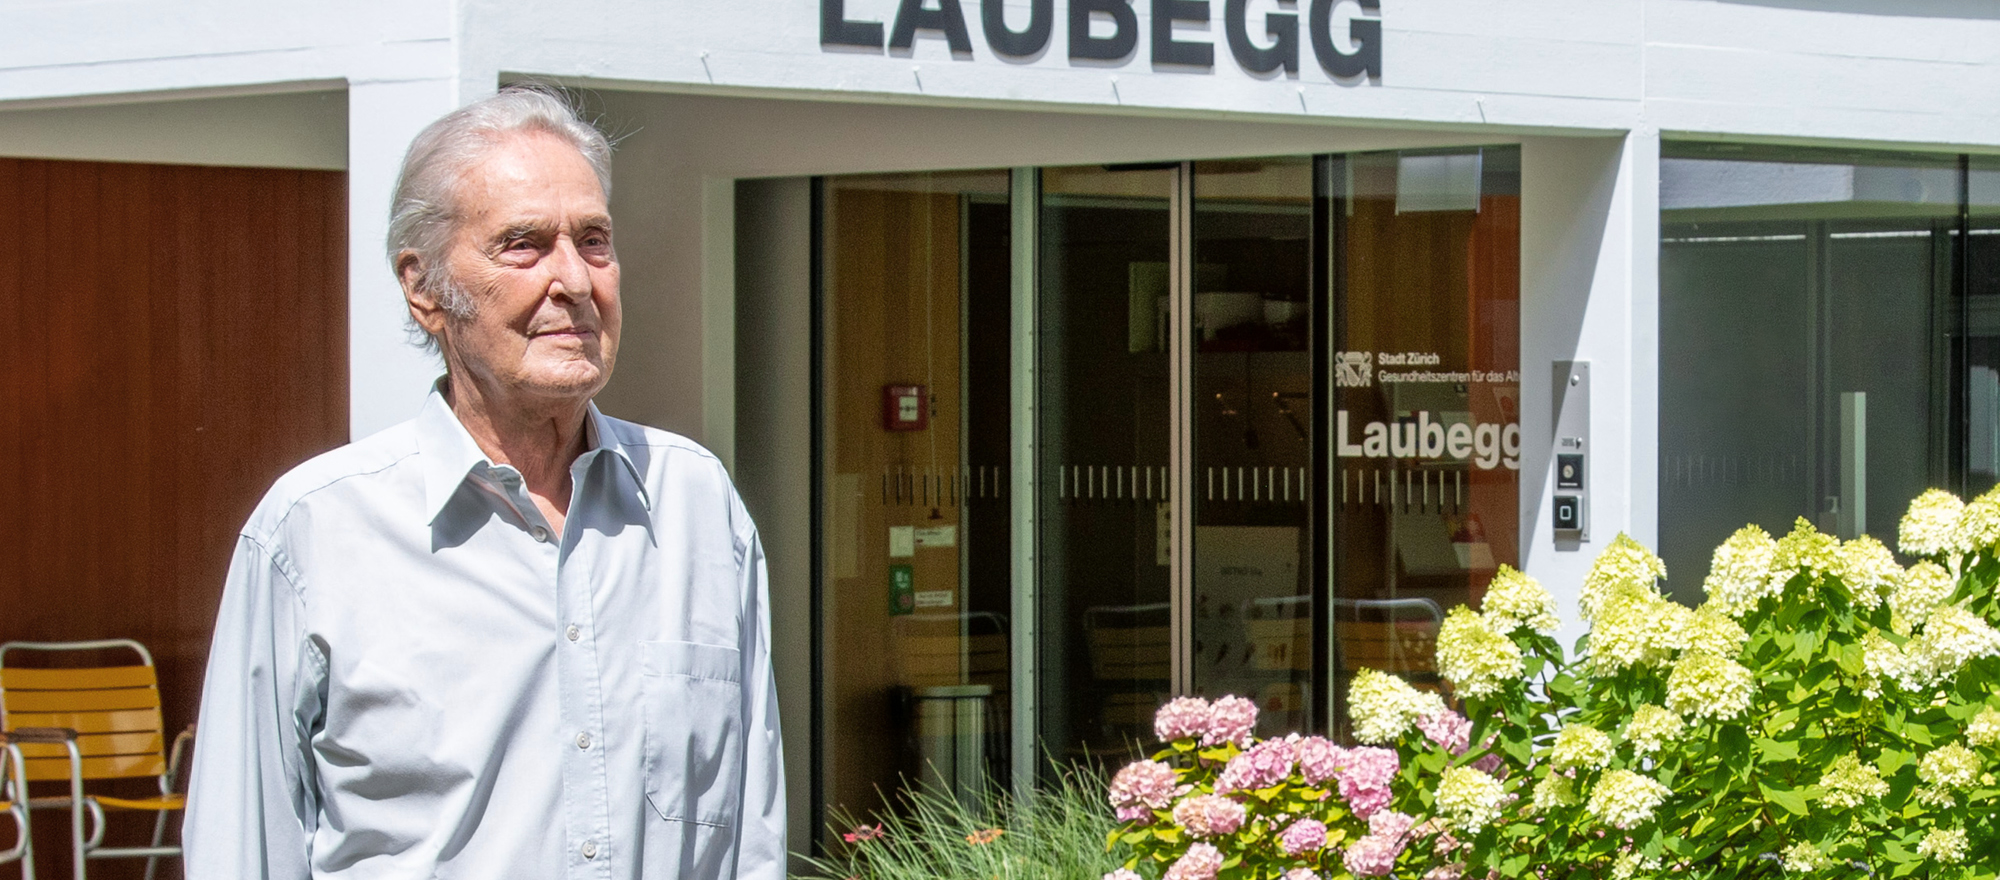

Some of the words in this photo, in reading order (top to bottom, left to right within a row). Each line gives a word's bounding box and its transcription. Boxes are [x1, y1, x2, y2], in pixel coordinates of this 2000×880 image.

[1378, 352, 1406, 365] Stadt
[1407, 352, 1440, 365] Zürich
[1378, 370, 1470, 383] Gesundheitszentren
[1471, 371, 1485, 383] für
[1486, 371, 1504, 383] das
[1337, 410, 1520, 470] Laubegg
